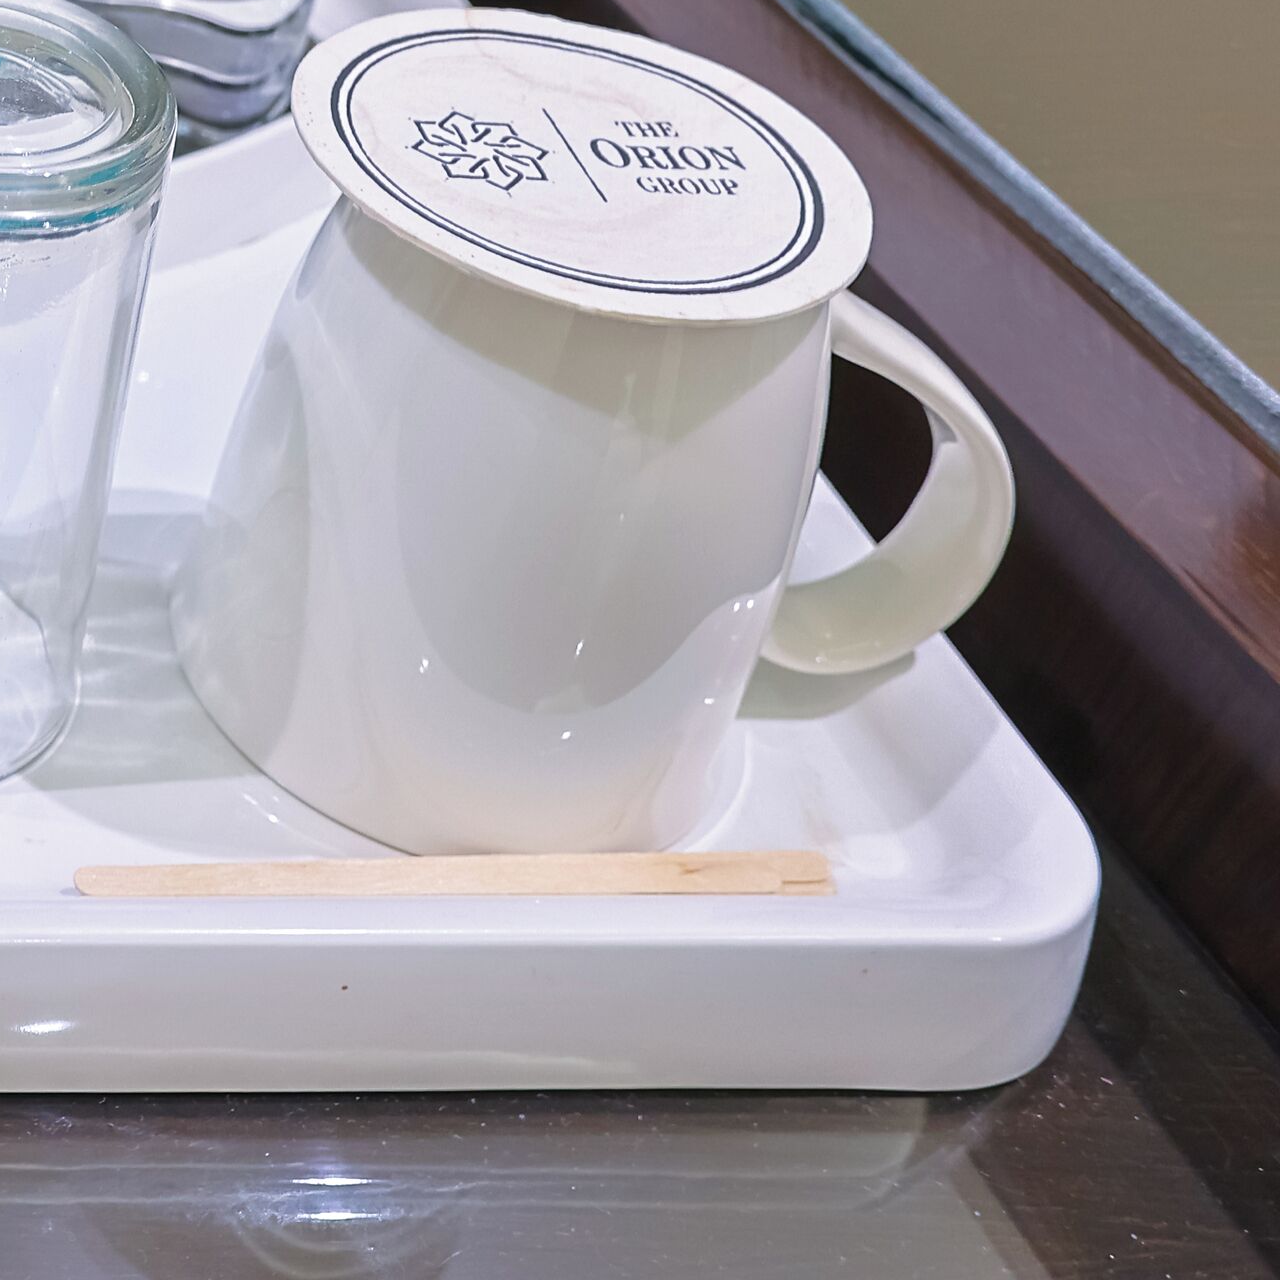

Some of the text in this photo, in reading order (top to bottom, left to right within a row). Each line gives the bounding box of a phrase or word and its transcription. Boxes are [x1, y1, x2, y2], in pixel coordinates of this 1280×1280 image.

[613, 120, 680, 138] THE
[589, 137, 747, 171] ORION
[635, 175, 739, 196] GROUP
